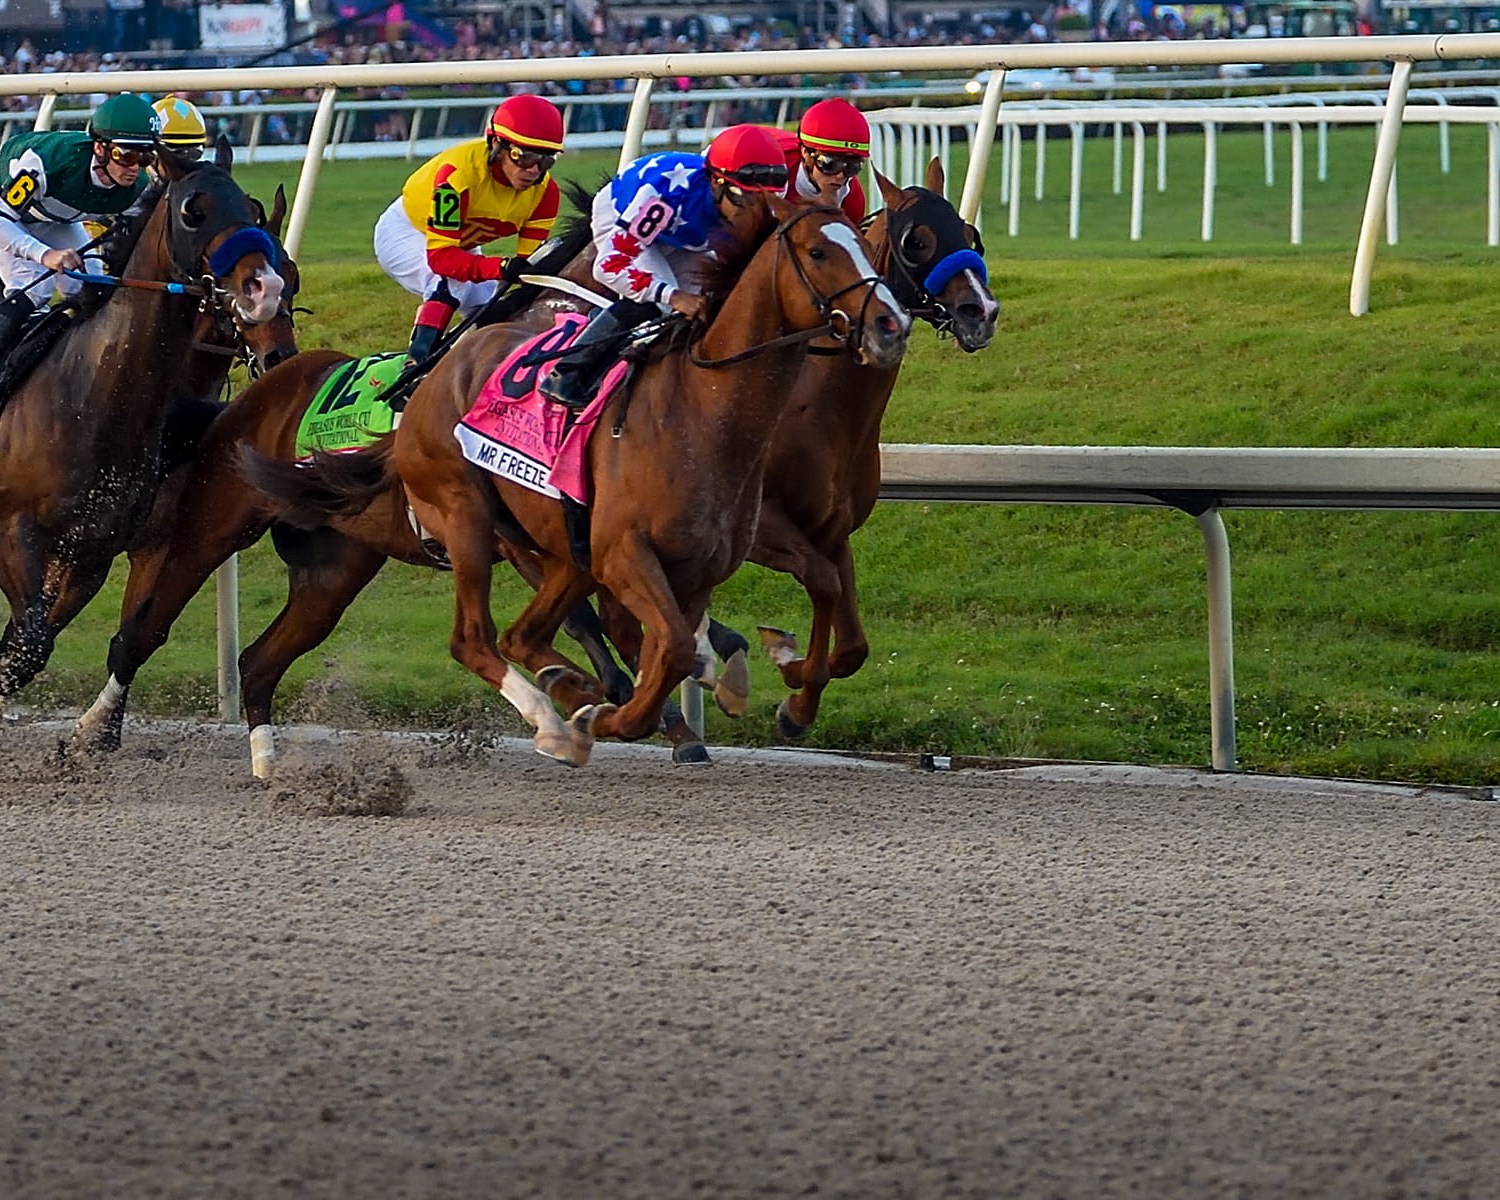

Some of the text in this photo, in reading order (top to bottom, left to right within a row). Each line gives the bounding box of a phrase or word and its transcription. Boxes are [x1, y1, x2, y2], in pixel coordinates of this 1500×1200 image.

[7, 175, 35, 206] 6
[434, 192, 461, 228] 12
[636, 204, 665, 238] 8
[501, 319, 581, 399] 8
[477, 442, 547, 490] MR FREEZE
